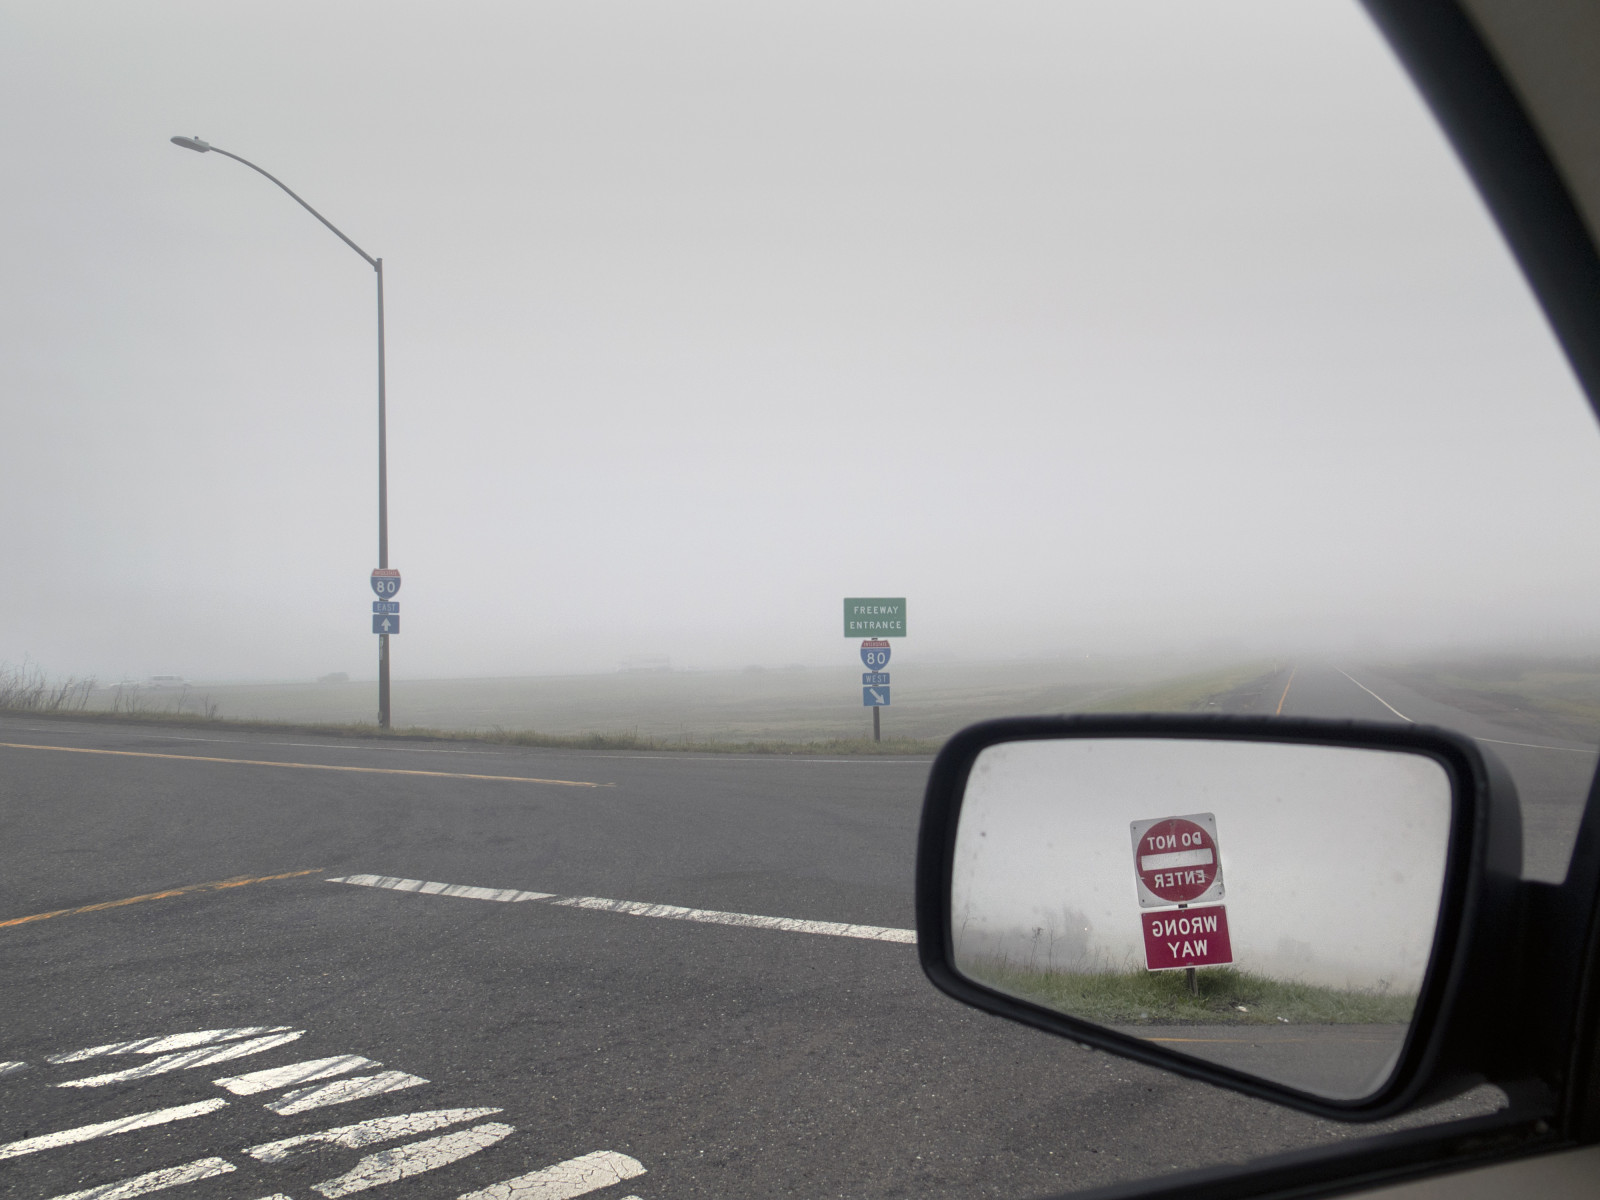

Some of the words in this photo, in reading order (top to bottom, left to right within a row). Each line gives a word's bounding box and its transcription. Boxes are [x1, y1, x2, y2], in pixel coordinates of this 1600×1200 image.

[376, 581, 396, 593] 80
[376, 603, 396, 612] EAST
[853, 606, 899, 615] FREEWAY
[849, 621, 902, 630] ENTRANCE
[867, 652, 886, 665] 80
[865, 674, 887, 683] WEST
